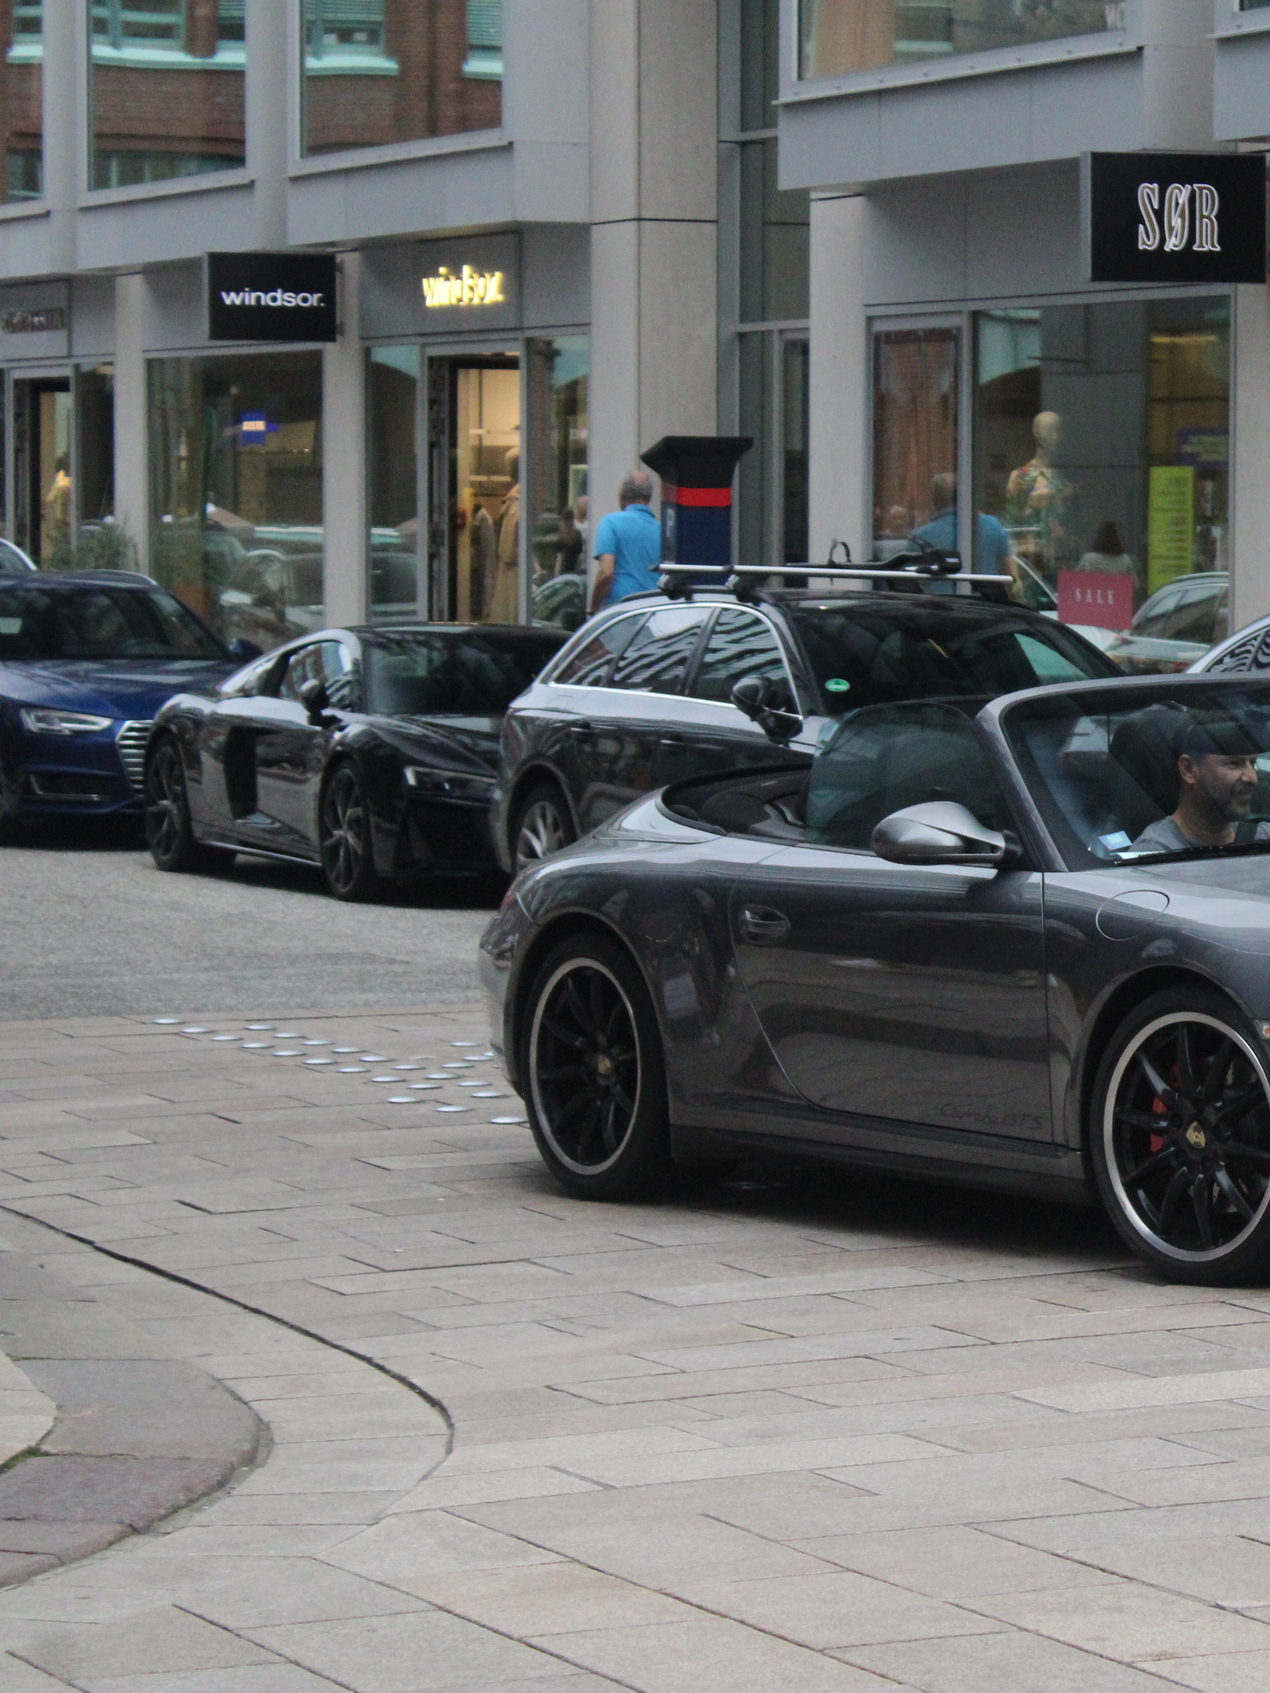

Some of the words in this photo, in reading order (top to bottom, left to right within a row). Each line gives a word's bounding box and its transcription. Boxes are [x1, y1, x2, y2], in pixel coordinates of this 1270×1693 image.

[1137, 183, 1221, 252] SØR
[220, 286, 326, 307] windsor.
[1075, 588, 1114, 605] SALE
